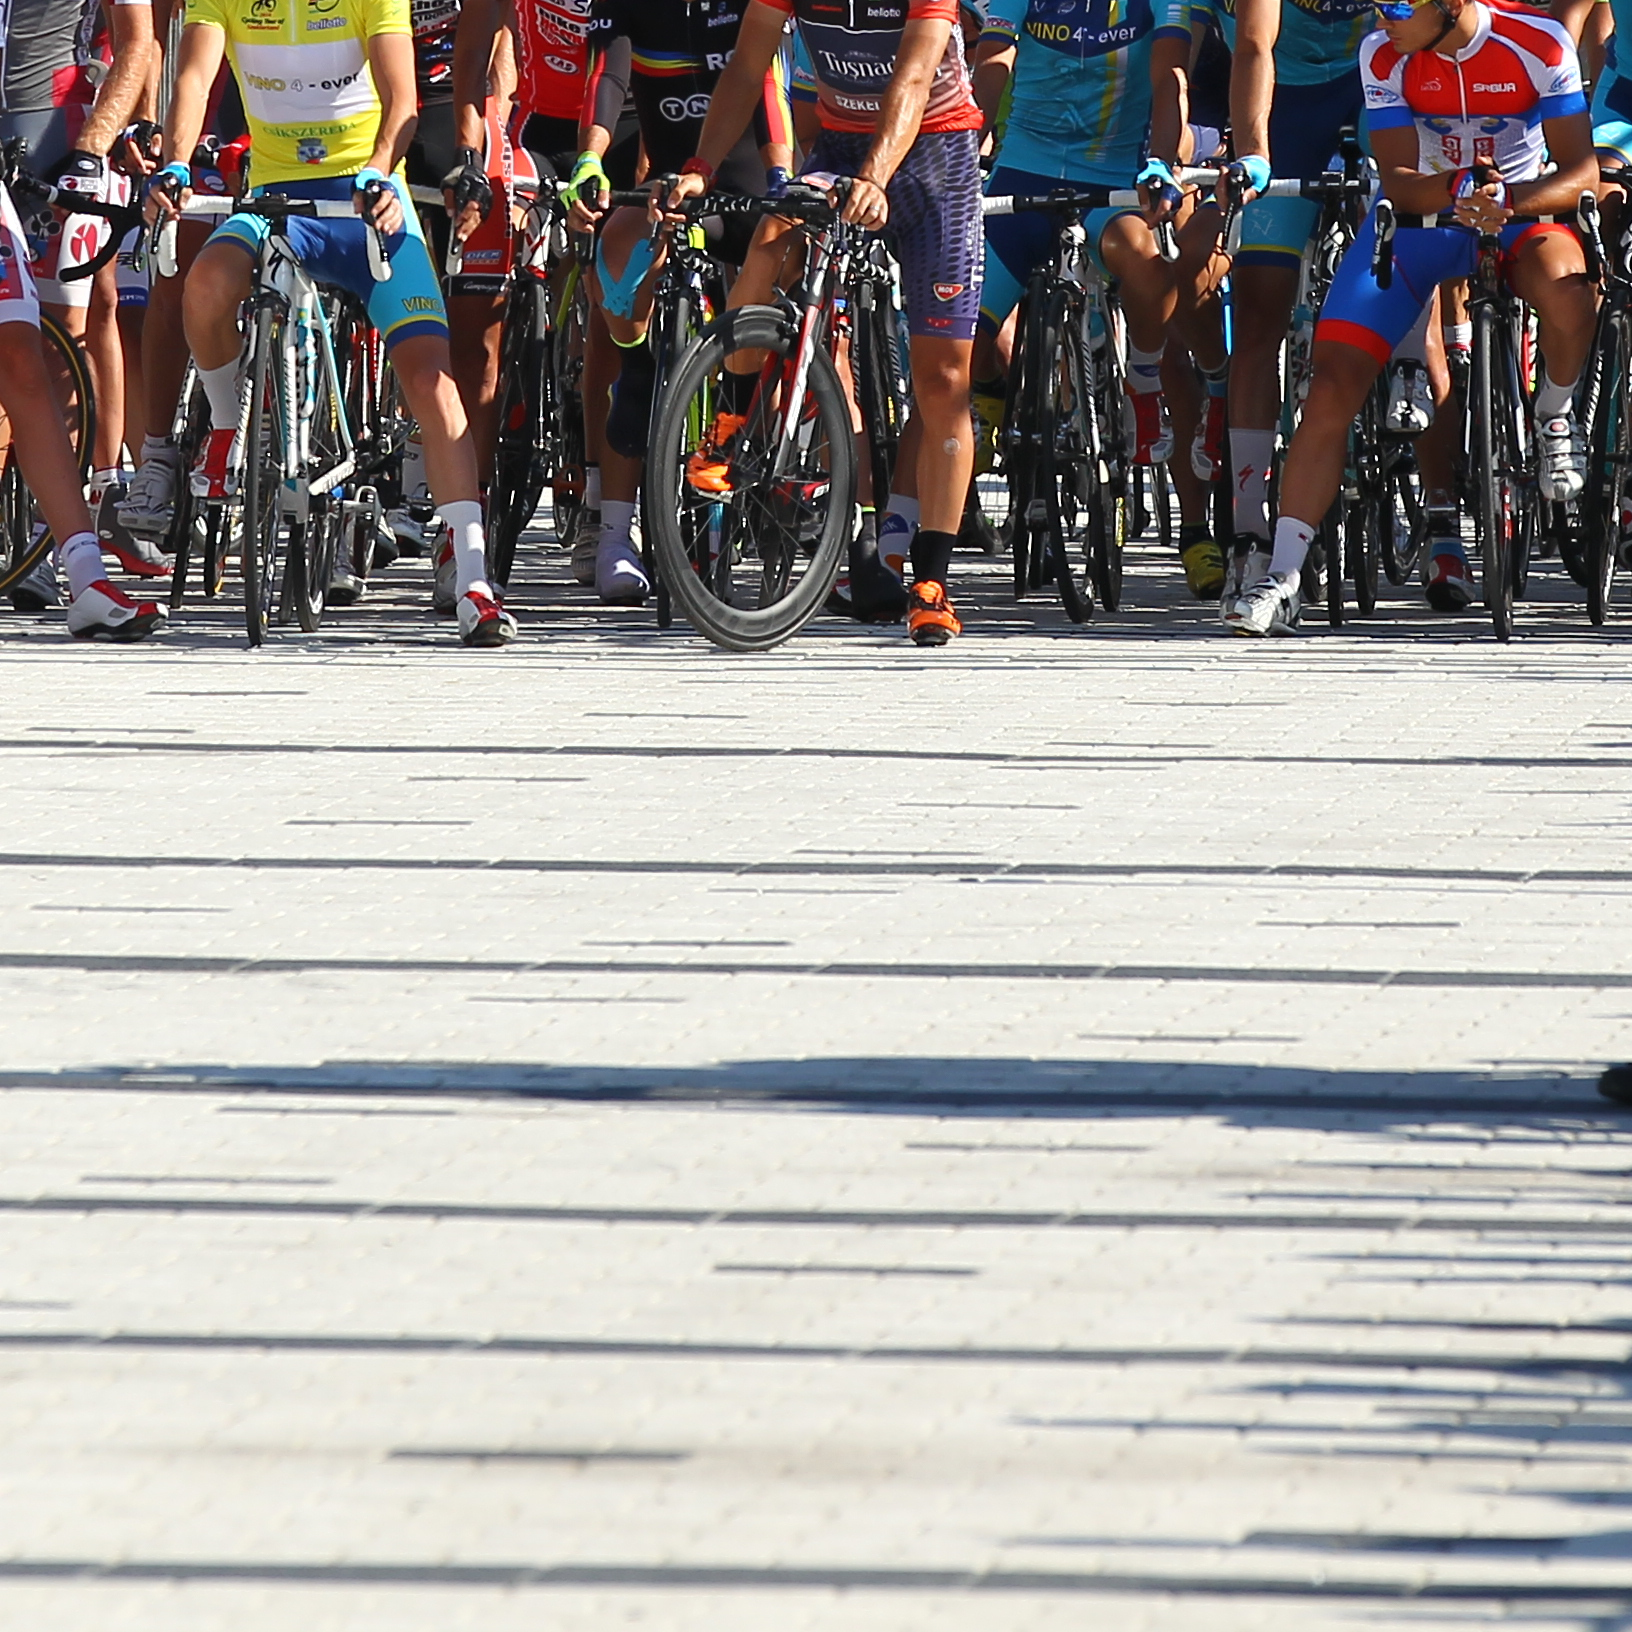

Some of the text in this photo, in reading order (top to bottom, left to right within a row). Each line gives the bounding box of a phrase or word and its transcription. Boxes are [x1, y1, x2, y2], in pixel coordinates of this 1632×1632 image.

[867, 6, 901, 18] bellotto
[307, 16, 348, 31] bellotto
[1026, 21, 1070, 41] VINO
[1072, 28, 1084, 43] 4
[1098, 25, 1137, 43] ever
[245, 71, 286, 91] VINO
[291, 79, 304, 92] 4
[321, 71, 359, 90] ever
